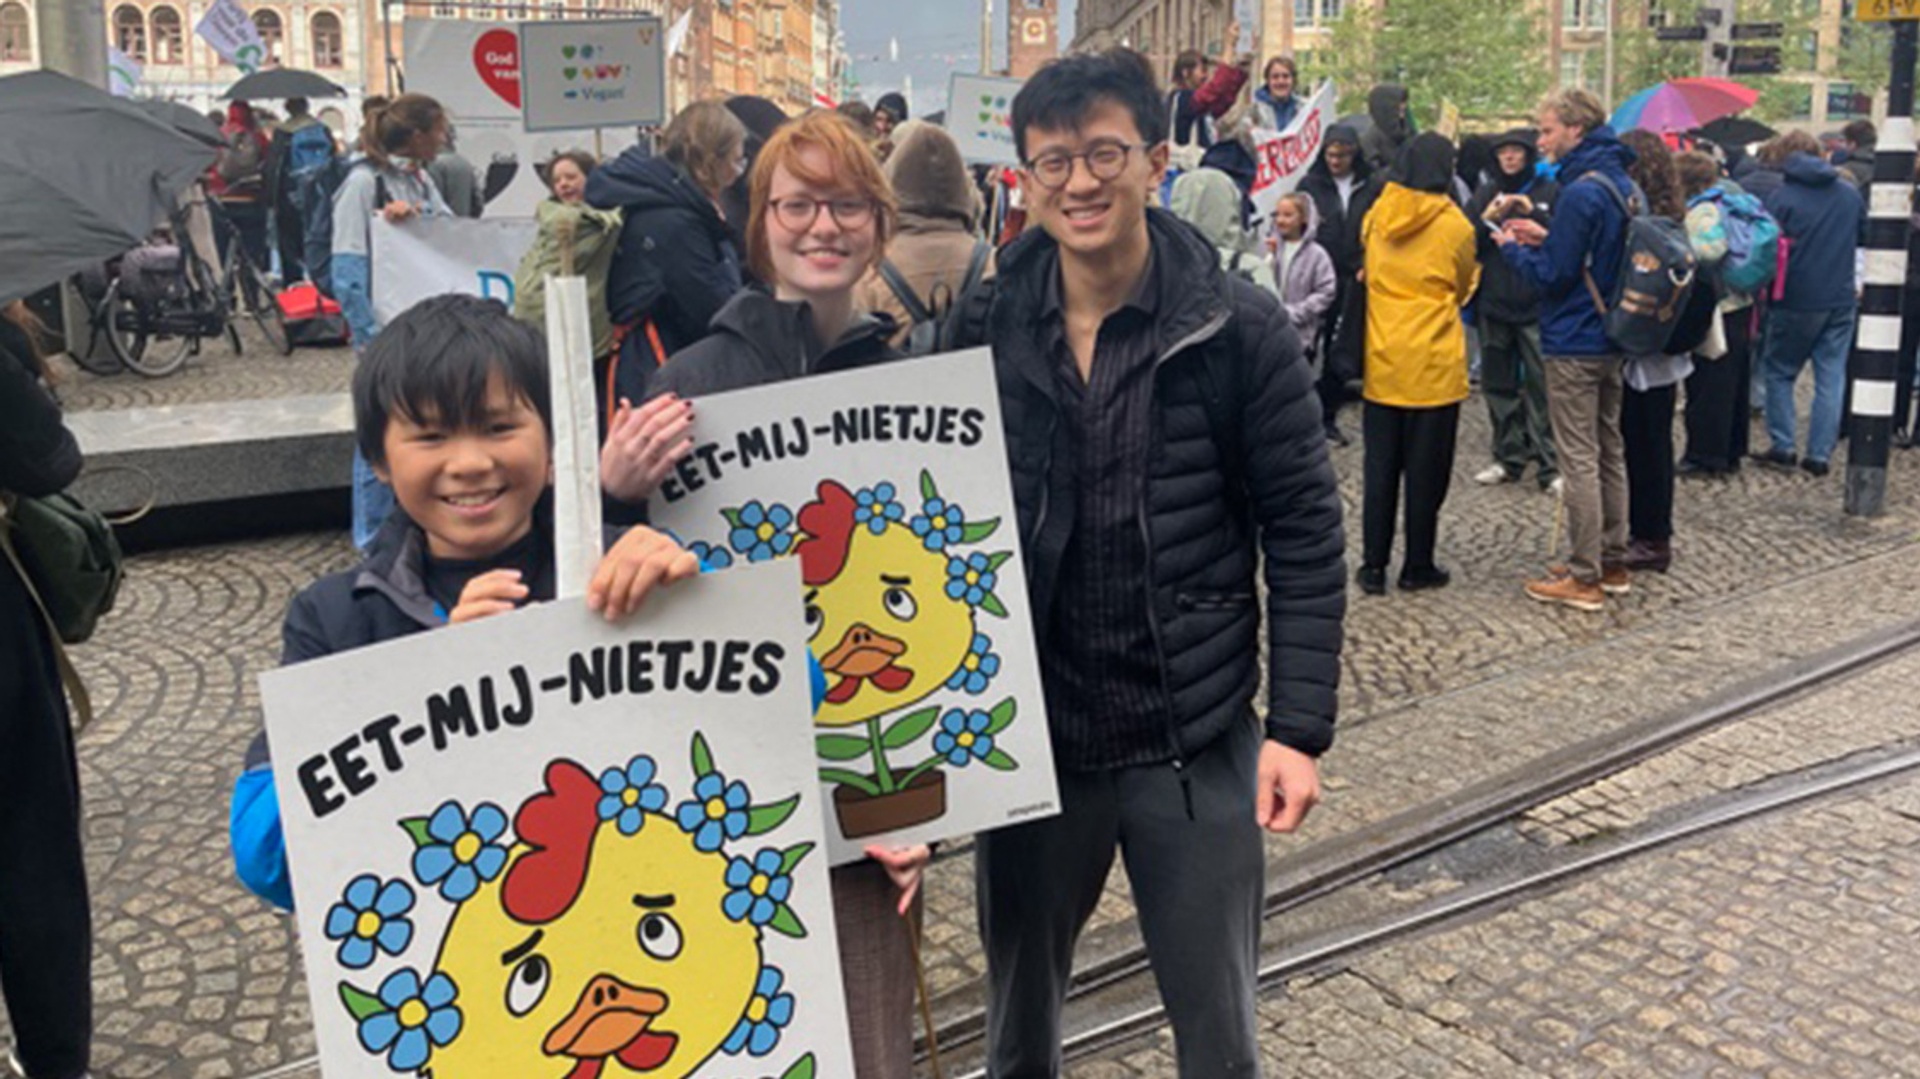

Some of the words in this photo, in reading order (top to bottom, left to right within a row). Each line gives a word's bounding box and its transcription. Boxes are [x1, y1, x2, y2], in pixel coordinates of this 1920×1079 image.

[484, 51, 513, 66] God
[477, 269, 517, 307] D
[660, 405, 985, 504] EET-MIJ-NIETJES
[296, 640, 786, 819] EET-MIJ-NIETJES
